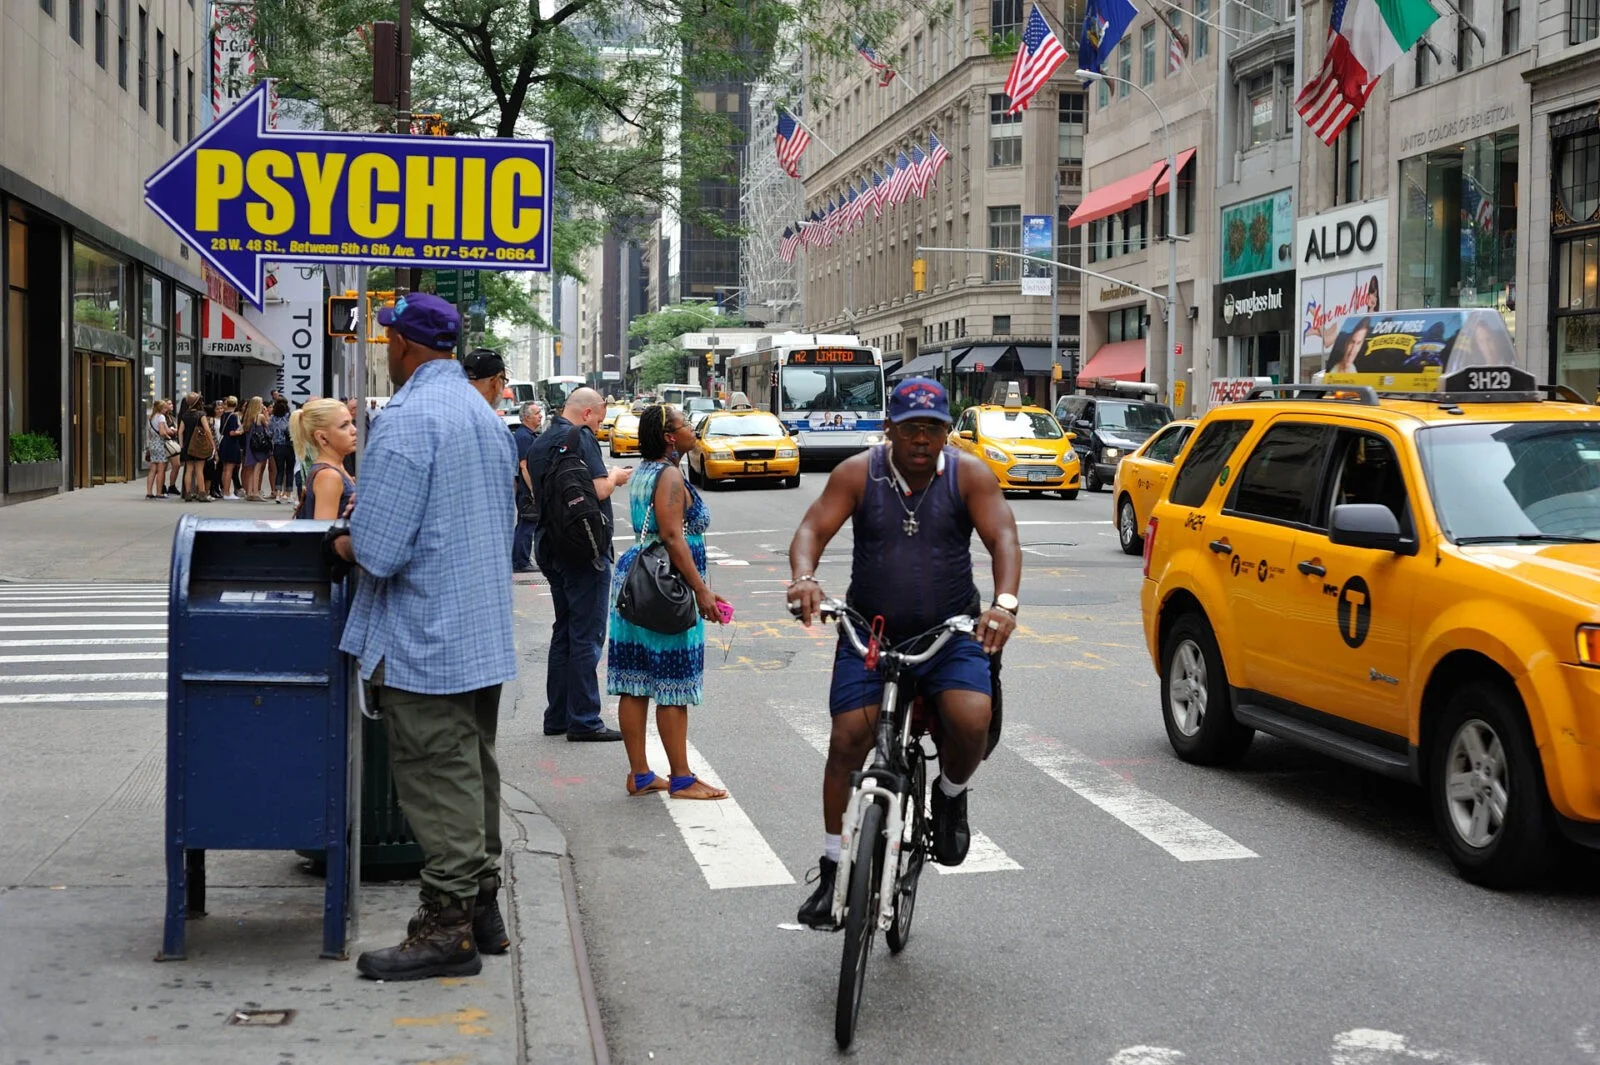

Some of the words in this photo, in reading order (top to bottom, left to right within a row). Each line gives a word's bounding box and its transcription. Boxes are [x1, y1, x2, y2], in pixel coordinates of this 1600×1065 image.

[1399, 131, 1426, 152] UNITED
[1428, 120, 1457, 143] COLORS
[1460, 116, 1470, 133] OF
[195, 148, 542, 244] PSYCHIC
[211, 238, 226, 250] 28
[228, 238, 242, 250] W.
[246, 239, 262, 251] 48
[289, 241, 339, 254] Between
[341, 242, 360, 255] 5th
[361, 245, 368, 254] &
[371, 244, 390, 256] 6th
[393, 245, 415, 257] Ave.
[423, 245, 536, 261] 917-547-0664
[1304, 215, 1378, 263] ALDO
[1235, 290, 1268, 319] sunglass
[1268, 287, 1283, 310] hut
[1334, 303, 1347, 317] me
[1372, 320, 1402, 334] DON'T
[1400, 319, 1426, 333] MISS
[816, 351, 854, 362] LIMITED
[1469, 371, 1511, 389] 3H29
[1209, 382, 1227, 401] THE
[1184, 512, 1206, 532] 3H29
[1345, 588, 1365, 639] T
